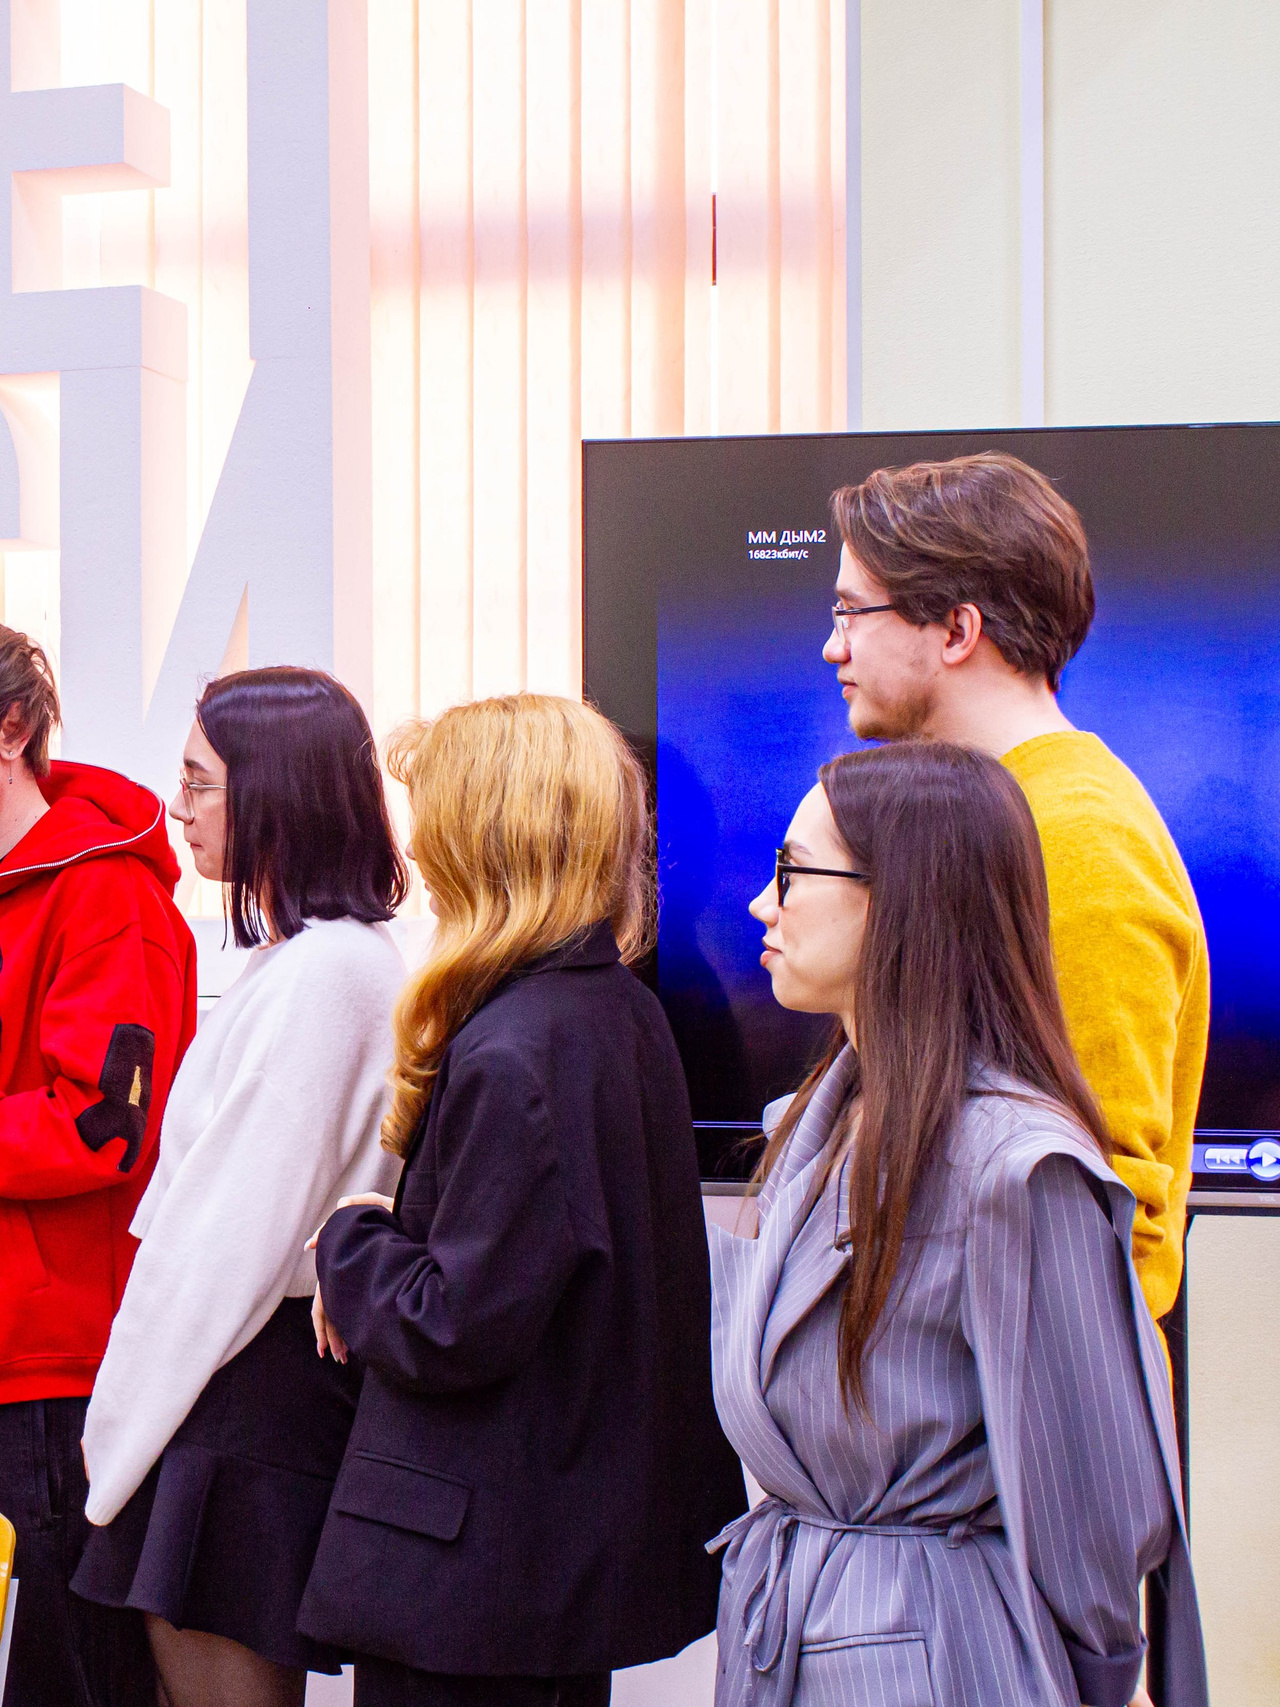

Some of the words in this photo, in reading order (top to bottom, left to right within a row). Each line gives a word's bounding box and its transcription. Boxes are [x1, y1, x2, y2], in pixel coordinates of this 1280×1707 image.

[748, 531, 777, 544] ММ
[780, 530, 826, 546] ДЫМ2
[748, 549, 809, 560] 16823кбит/с
